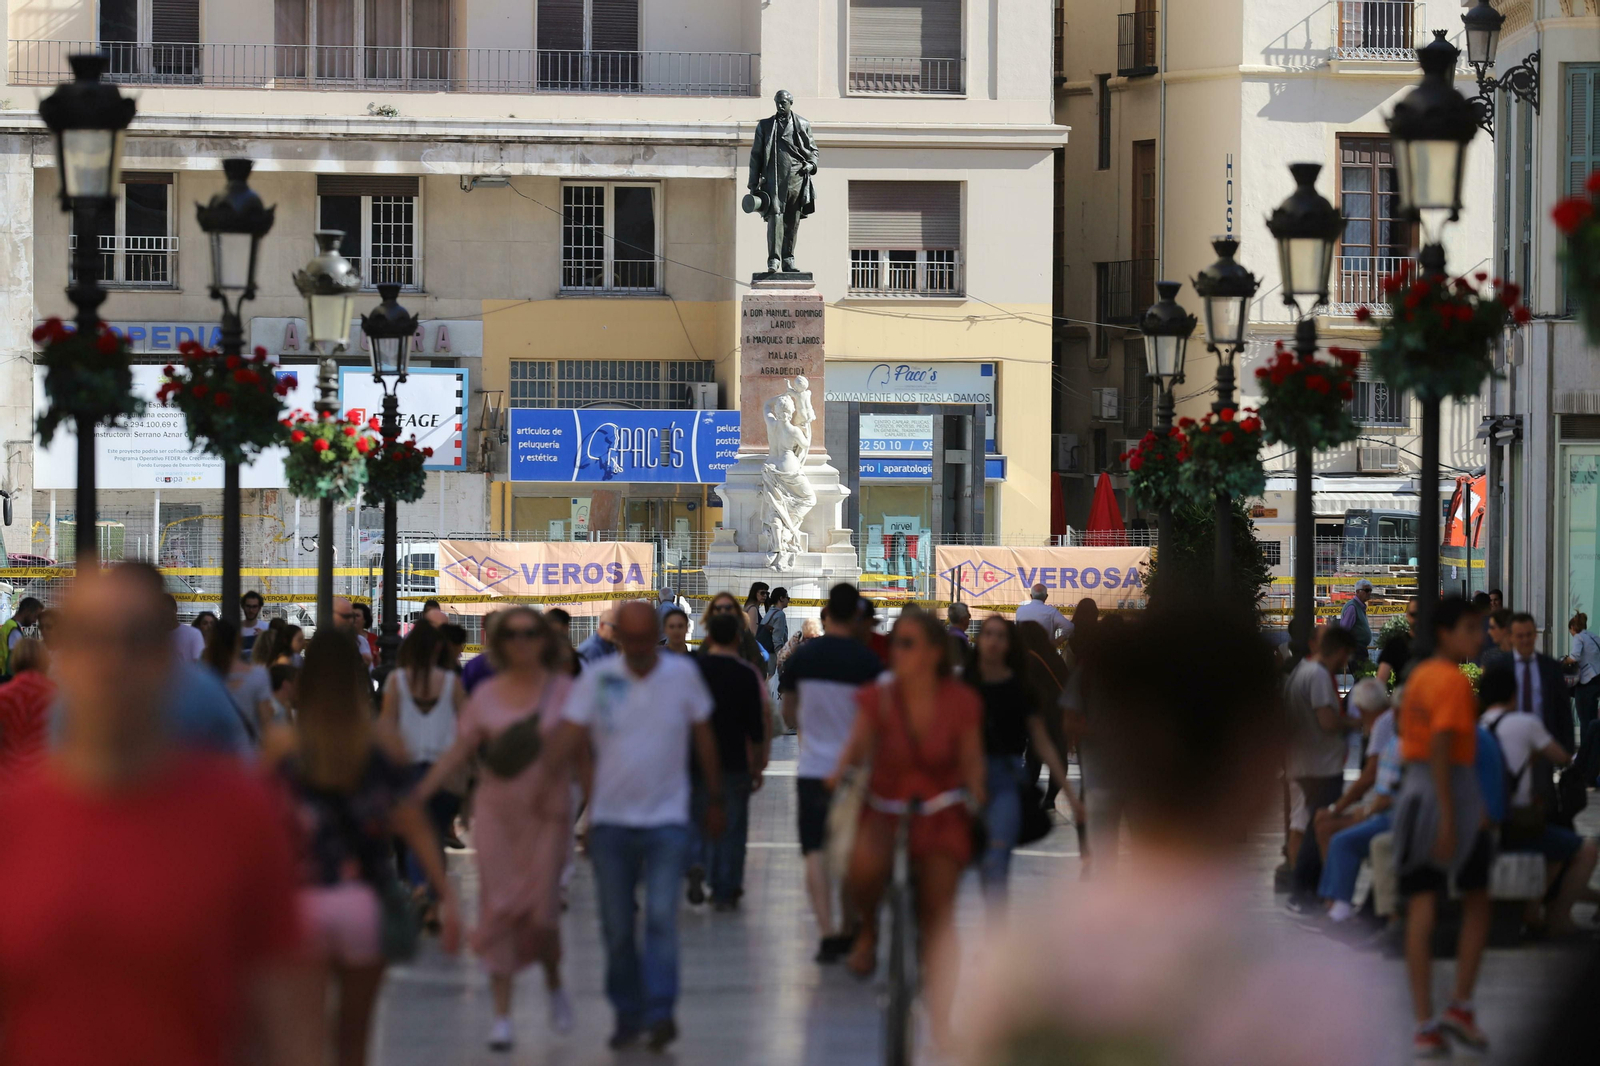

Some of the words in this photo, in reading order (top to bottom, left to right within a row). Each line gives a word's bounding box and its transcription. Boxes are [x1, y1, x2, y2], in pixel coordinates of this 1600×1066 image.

[750, 309, 763, 317] DON
[771, 321, 796, 329] LARIOS
[753, 336, 783, 345] MARQUES
[761, 367, 805, 375] AGRADECIDA
[894, 394, 916, 402] NOS
[920, 394, 990, 402] TRASLADAMOS
[516, 427, 550, 435] artículos
[518, 440, 560, 450] peluquería
[873, 441, 885, 450] 50
[890, 441, 901, 450] 10
[527, 454, 558, 462] estética
[890, 522, 912, 530] nirvel
[486, 567, 502, 578] G.
[520, 563, 646, 584] VEROSA
[983, 571, 998, 582] G.
[1017, 567, 1144, 588] VEROSA
